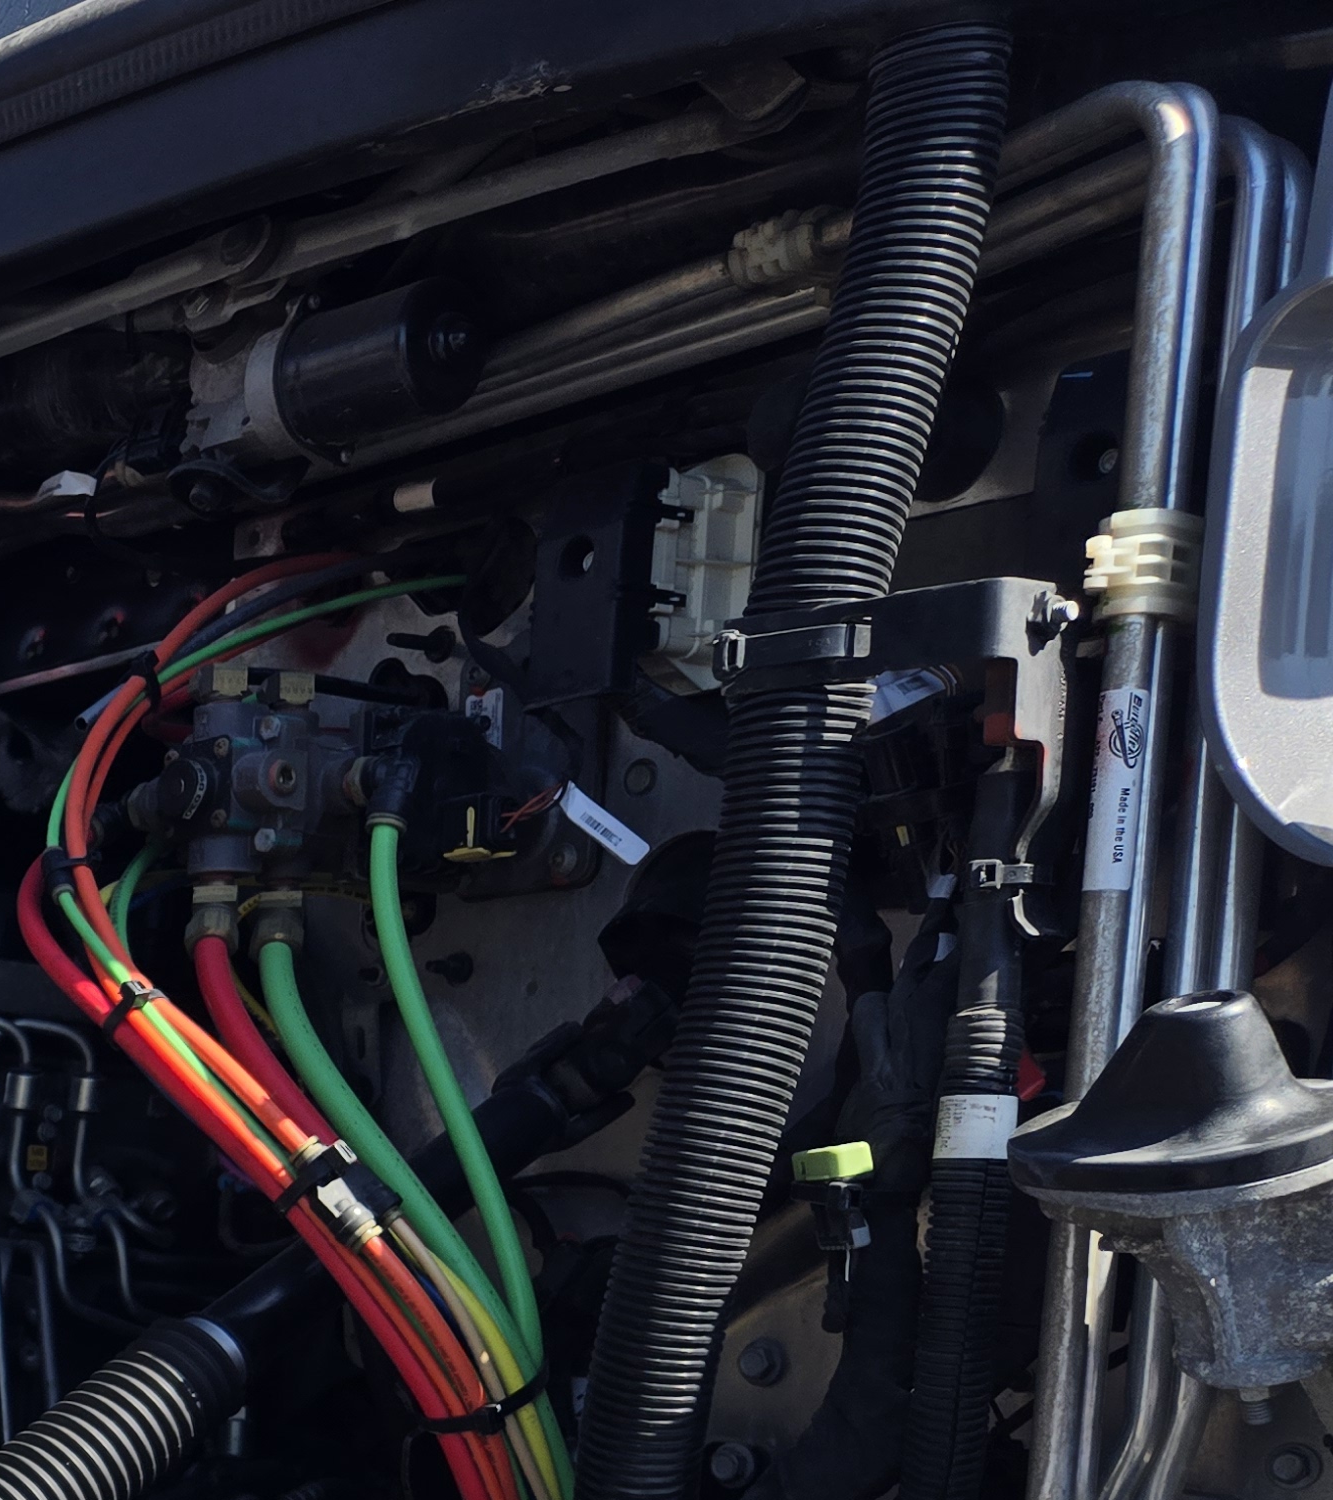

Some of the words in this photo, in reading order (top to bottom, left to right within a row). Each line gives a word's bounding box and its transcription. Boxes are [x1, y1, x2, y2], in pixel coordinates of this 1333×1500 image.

[1120, 787, 1131, 813] Made
[1115, 827, 1125, 843] the
[1112, 844, 1124, 865] USA
